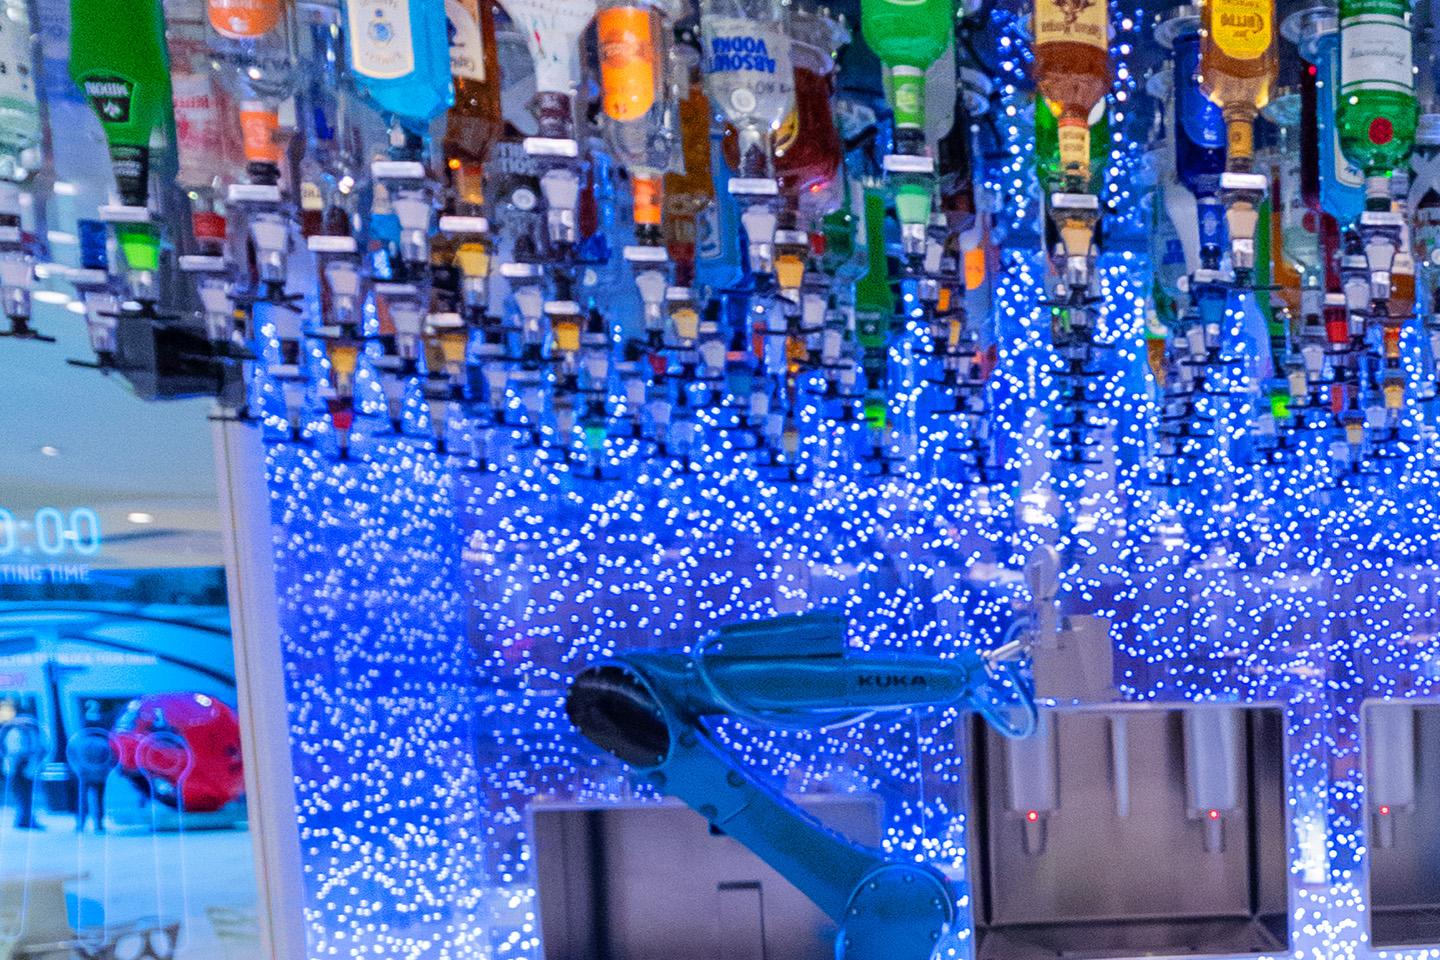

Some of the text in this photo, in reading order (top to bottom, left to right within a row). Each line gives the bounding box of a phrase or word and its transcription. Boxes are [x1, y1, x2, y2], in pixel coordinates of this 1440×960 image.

[711, 37, 769, 55] VODKA
[50, 564, 90, 582] TIME
[858, 674, 928, 688] KUKA
[84, 699, 102, 721] 2
